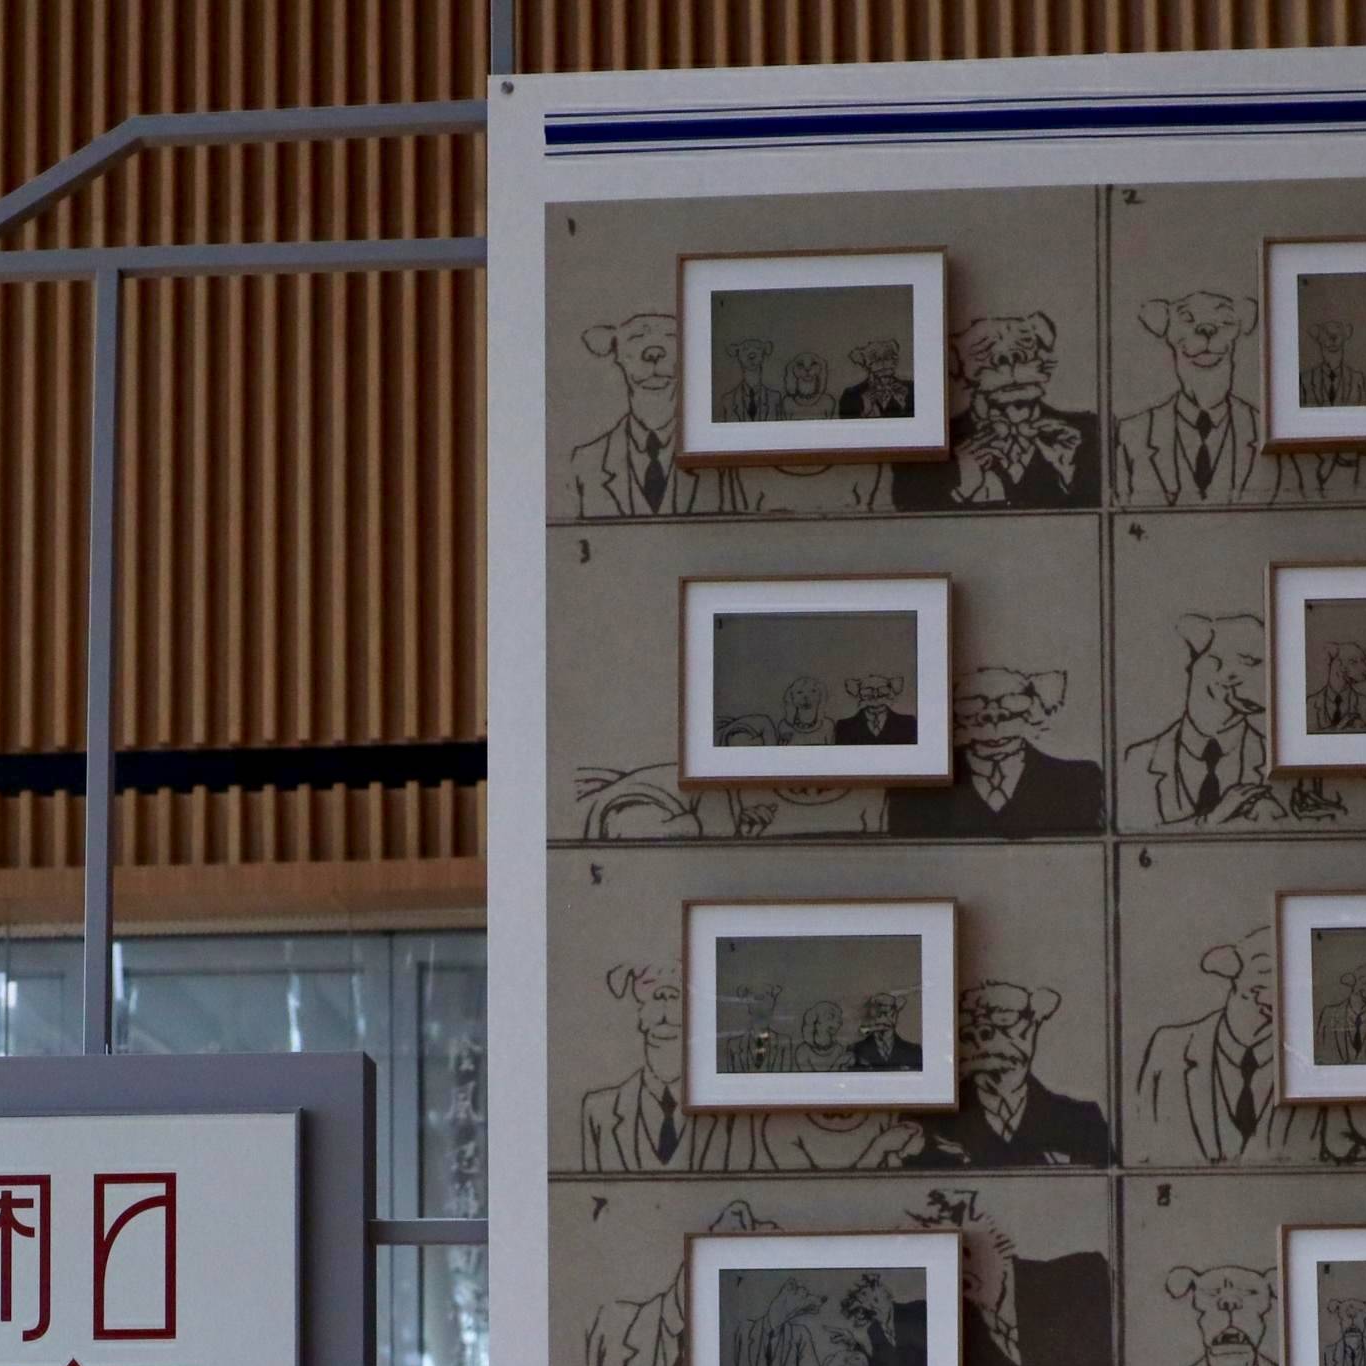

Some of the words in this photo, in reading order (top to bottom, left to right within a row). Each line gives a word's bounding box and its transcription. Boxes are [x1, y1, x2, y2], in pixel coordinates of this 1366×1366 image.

[579, 538, 591, 564] 3
[1139, 846, 1152, 868] 6
[591, 1195, 608, 1222] 7
